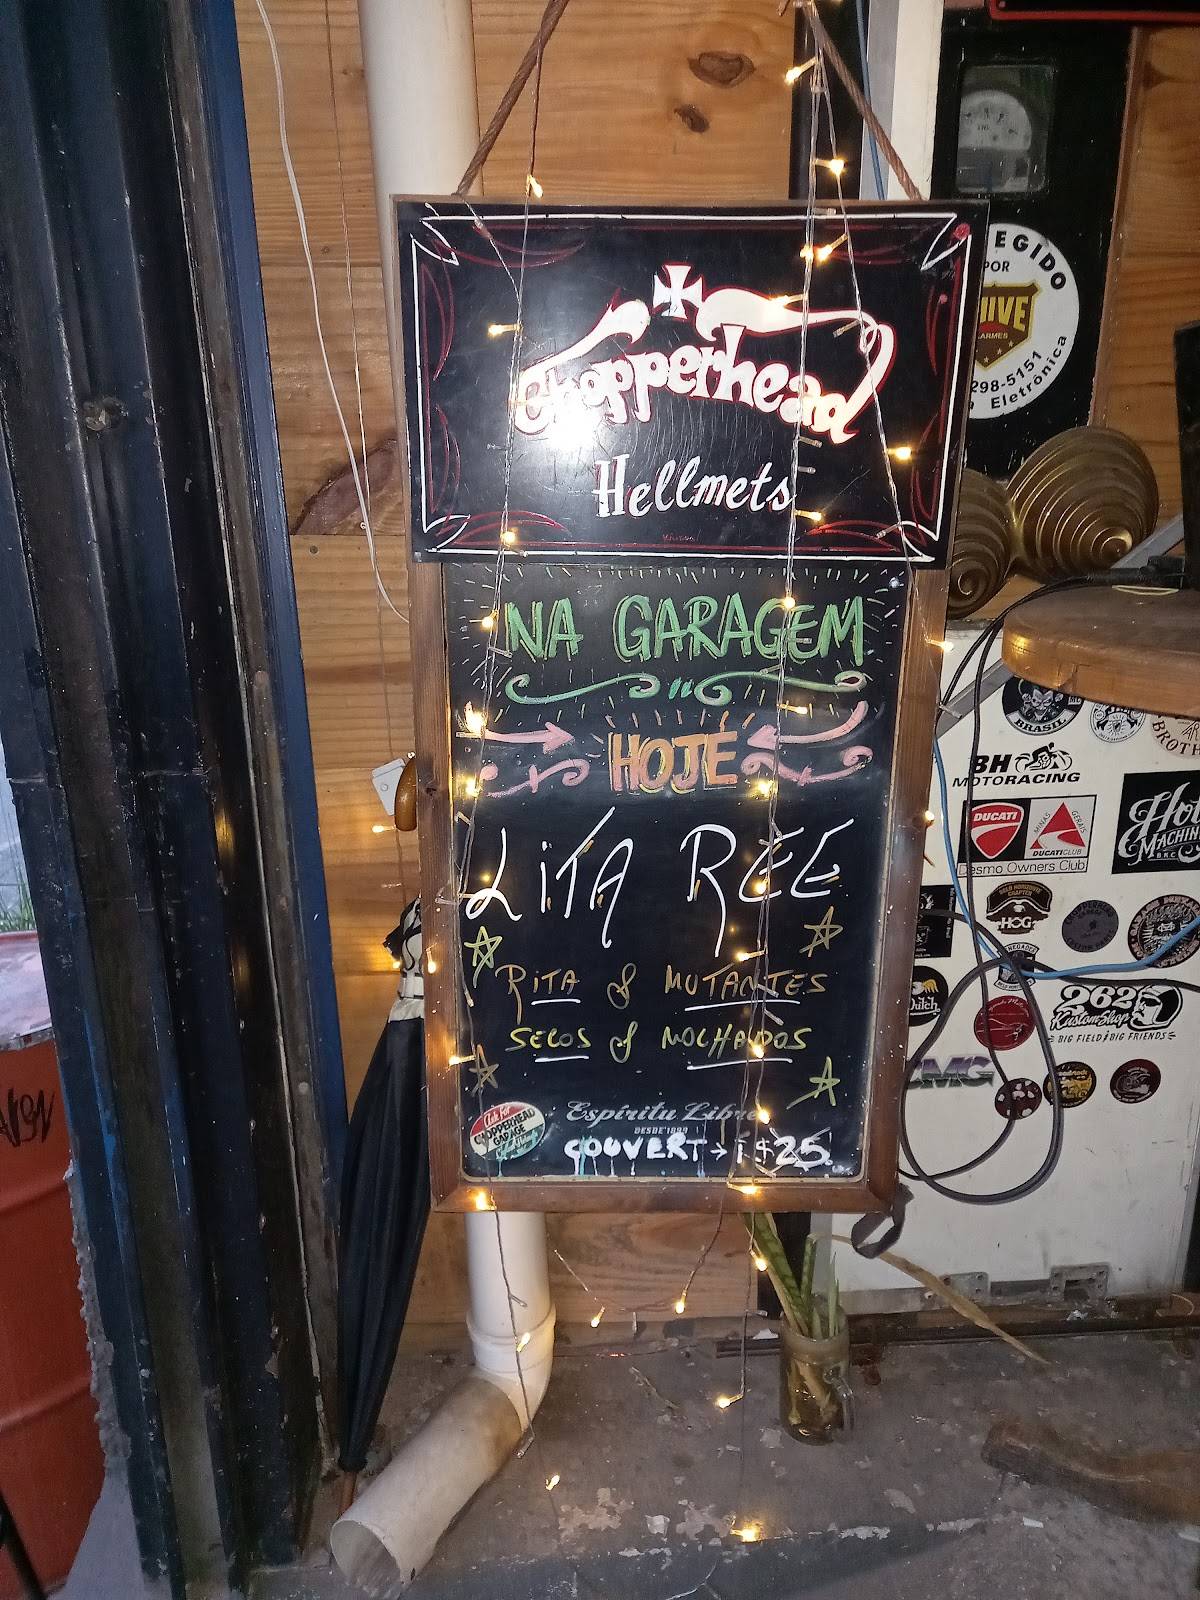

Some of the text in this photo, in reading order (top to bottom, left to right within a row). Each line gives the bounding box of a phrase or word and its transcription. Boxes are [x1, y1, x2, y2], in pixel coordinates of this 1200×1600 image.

[507, 318, 882, 443] Chopperhead
[991, 335, 1067, 410] Eletrônica
[593, 453, 796, 518] Hellmets
[503, 594, 865, 666] NA GARAGEM
[1014, 718, 1067, 733] BRASIL
[608, 730, 738, 794] HOJE
[973, 754, 1012, 774] BH
[952, 772, 1081, 787] MOTORACING
[973, 811, 1018, 821] DUCATI
[1034, 812, 1051, 834] MINAS
[1071, 810, 1087, 834] GERAIS
[1128, 826, 1200, 866] MACHIN
[958, 859, 1085, 875] Desmo Owners Club
[680, 819, 855, 957] REE
[664, 962, 829, 1001] MUTANTES
[1055, 984, 1137, 1016] 262
[1058, 1031, 1167, 1043] BIG FIELD BIG FRIENDS
[566, 1100, 678, 1129] Espíritu
[563, 1133, 708, 1163] COUVERT
